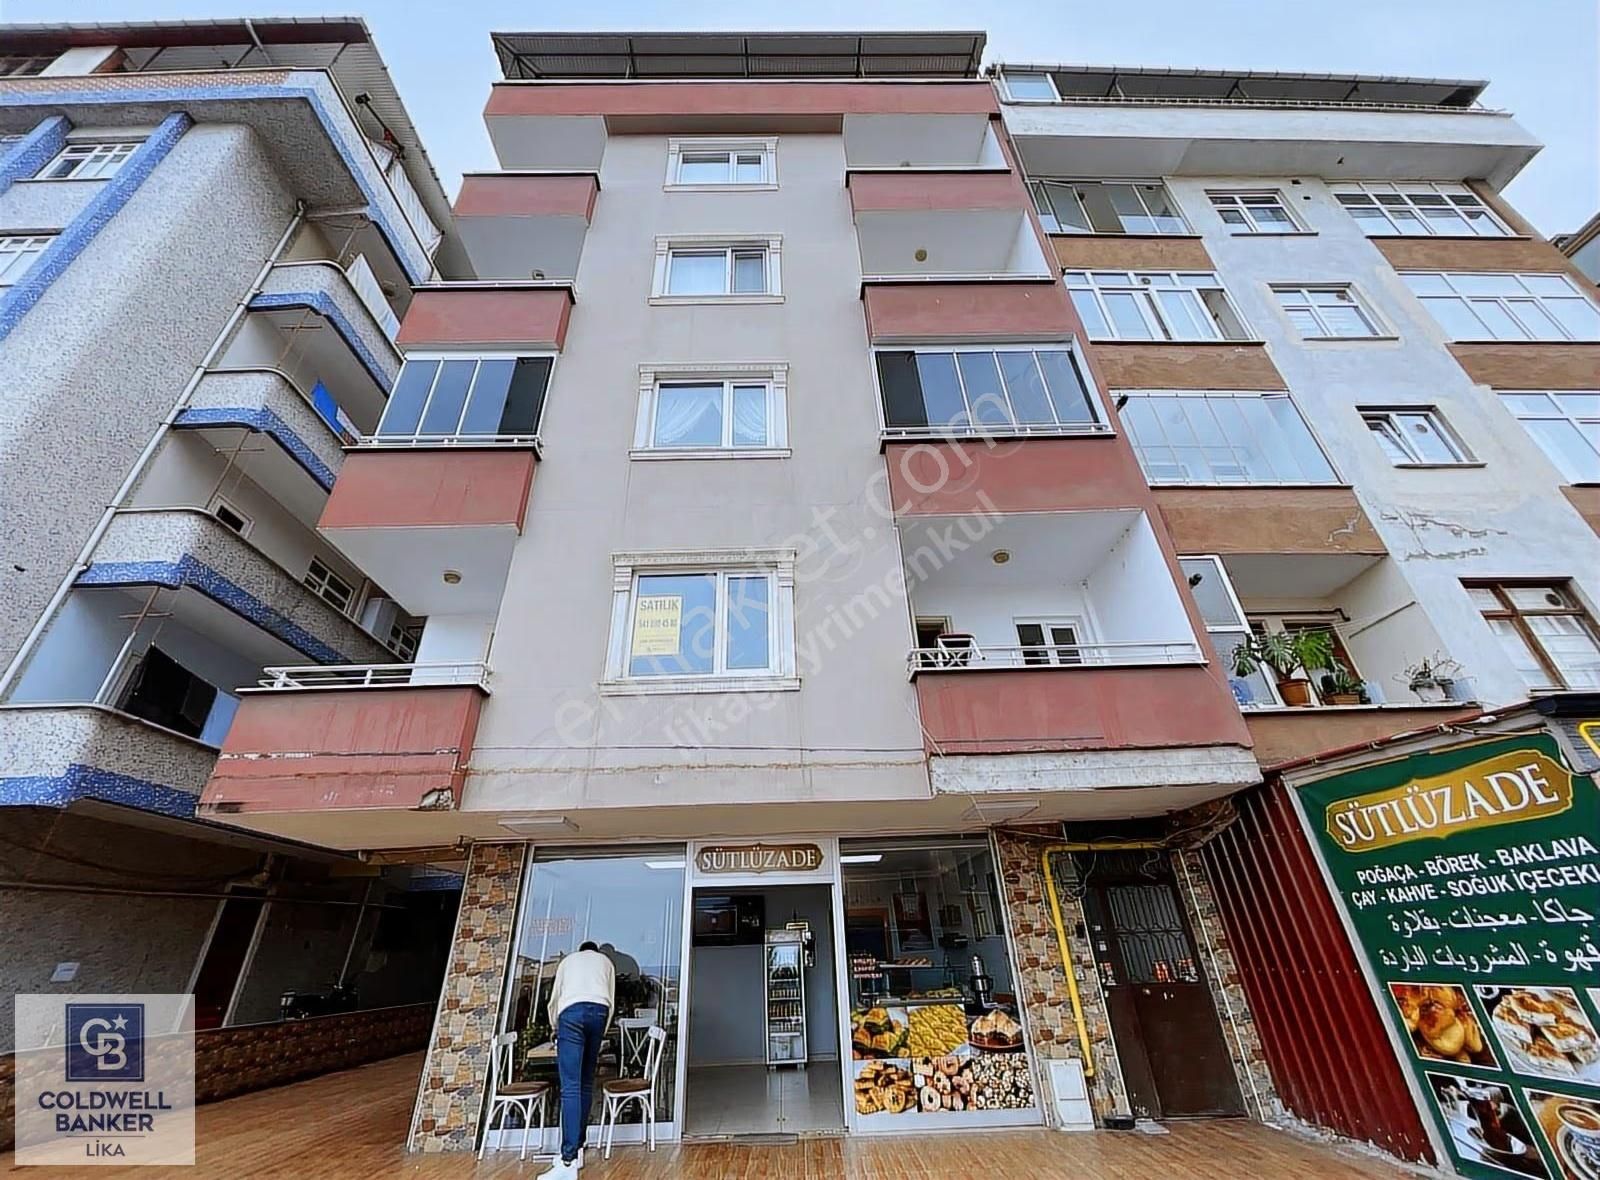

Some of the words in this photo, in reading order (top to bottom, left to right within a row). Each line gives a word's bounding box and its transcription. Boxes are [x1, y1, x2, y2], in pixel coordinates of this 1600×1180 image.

[640, 599, 679, 611] SATILIK
[1335, 763, 1558, 844] SÜTLÜZADE
[702, 846, 817, 870] SÜTLÜZADE
[1356, 864, 1418, 885] POĞAÇA
[1424, 853, 1487, 876] BÖREK
[1495, 836, 1599, 866] BAKLAVA
[1351, 890, 1377, 910] ÇAY
[1386, 884, 1439, 903] KAHVE
[1447, 874, 1515, 897] SOĞUK
